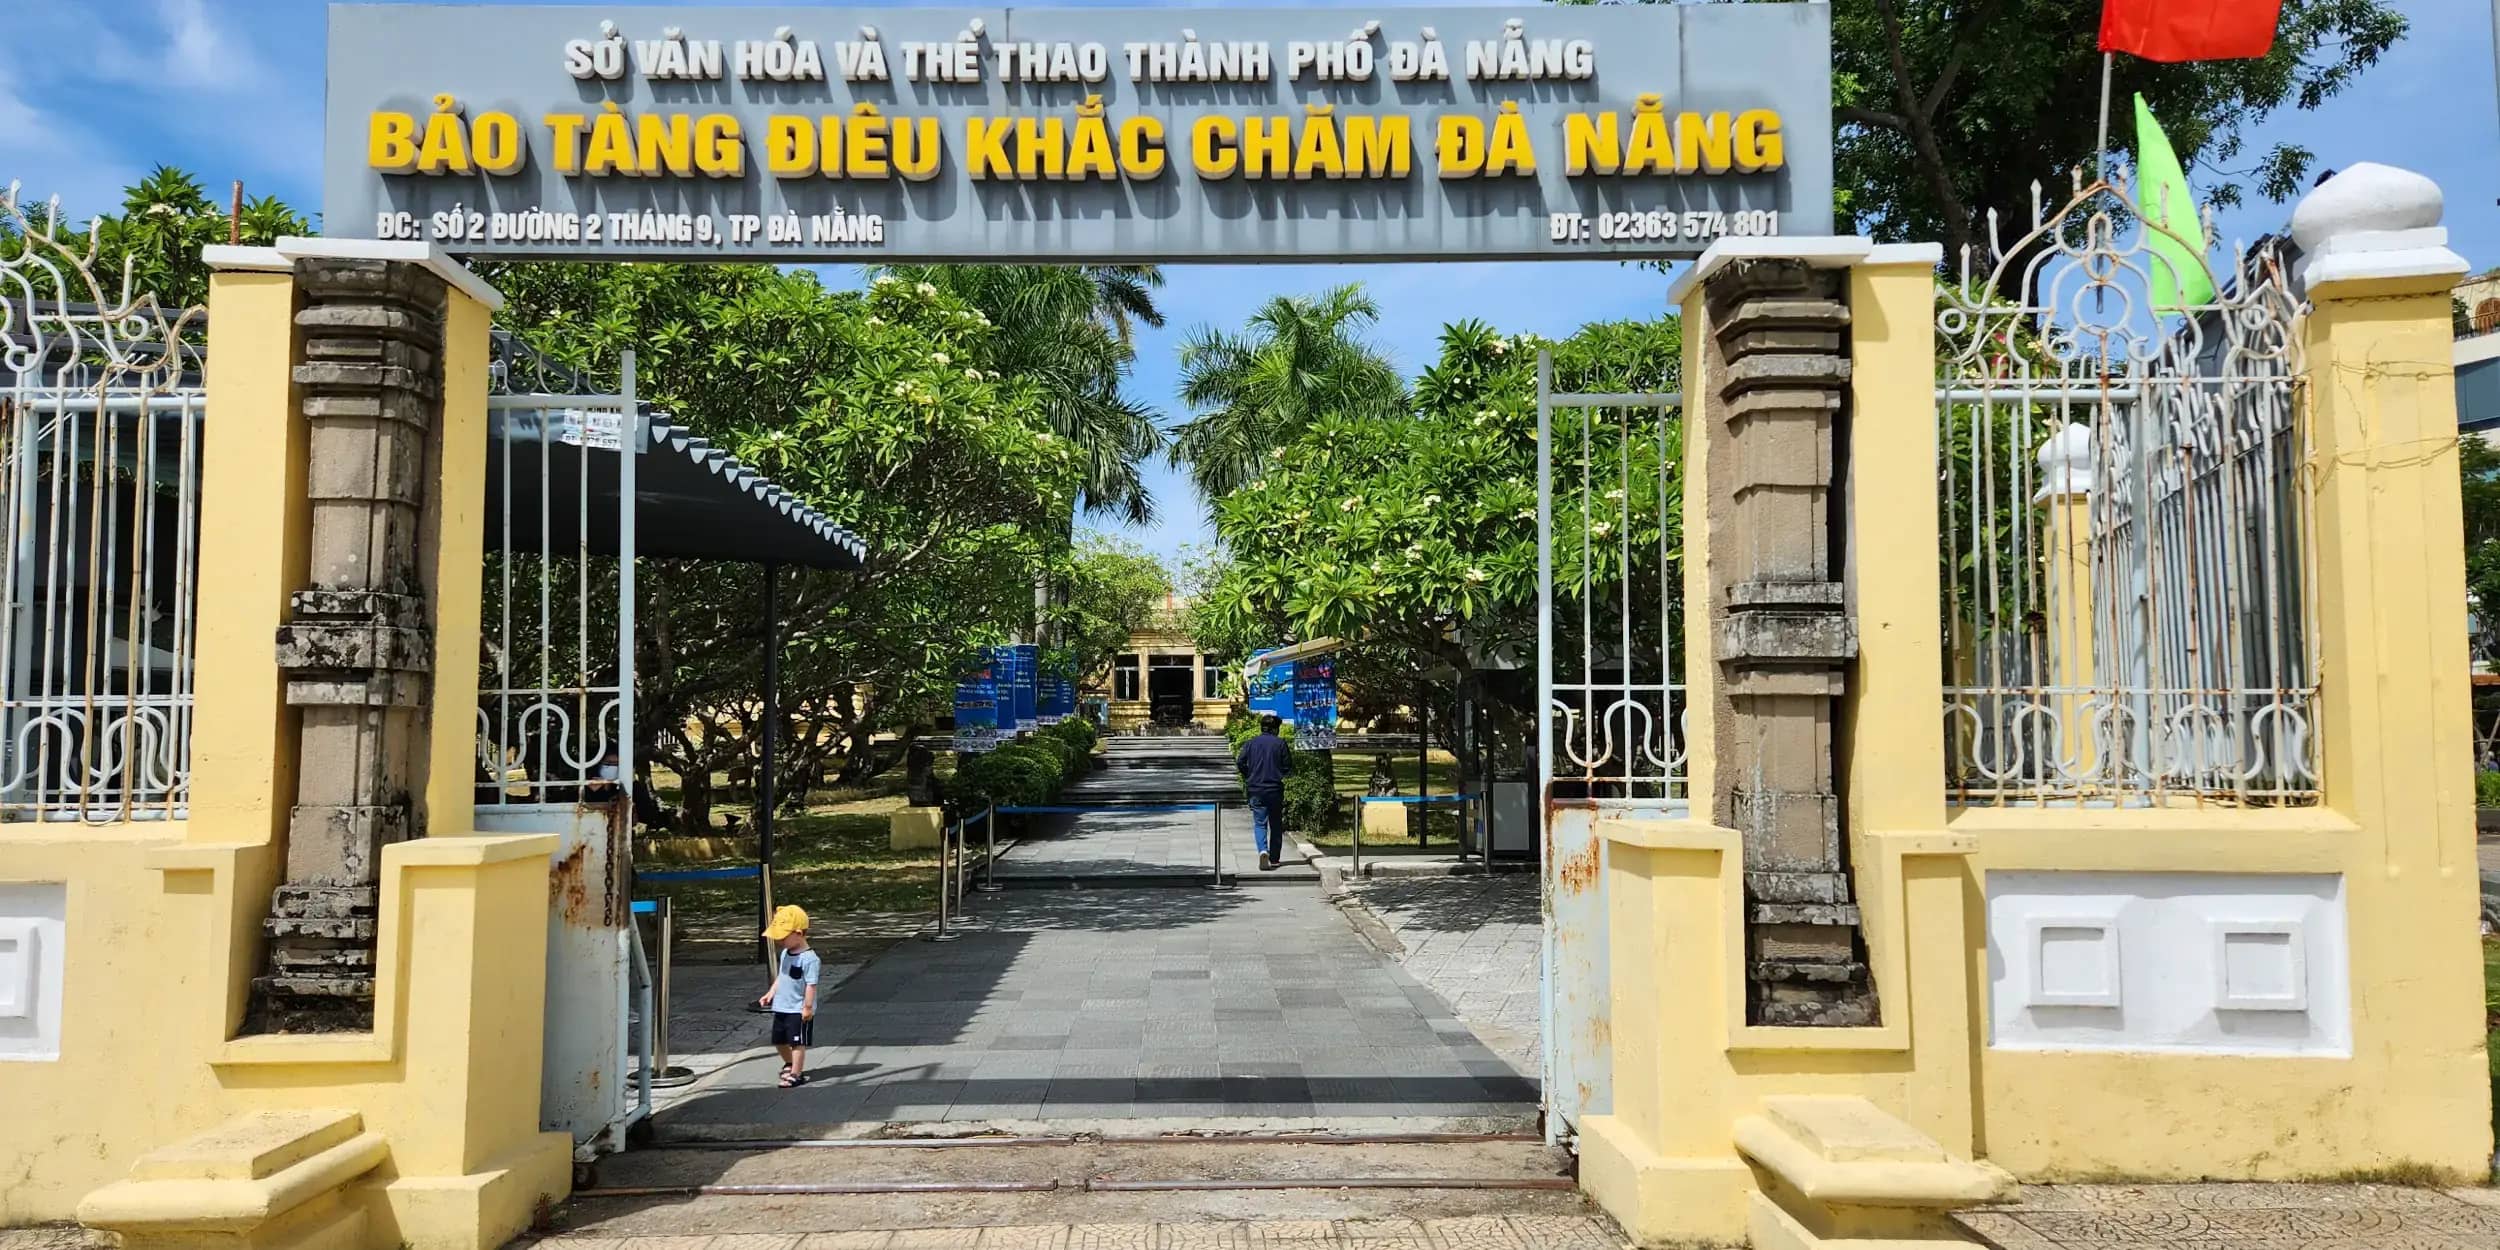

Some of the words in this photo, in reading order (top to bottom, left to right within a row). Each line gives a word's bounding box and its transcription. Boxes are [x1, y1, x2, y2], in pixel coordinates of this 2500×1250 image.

[564, 19, 627, 79] SỞ
[635, 25, 723, 79] VĂN
[735, 25, 824, 81] HÓA
[834, 25, 889, 81] VÀ
[901, 17, 980, 82] THỂ
[992, 41, 1107, 83] THAO
[1124, 28, 1270, 82] THÀNH
[1288, 20, 1380, 82] PHỐ
[1389, 26, 1449, 80] ĐÀ
[368, 92, 525, 176] BẢO
[543, 99, 745, 178] TÀNG
[765, 102, 941, 181] ĐIÊU
[966, 94, 1165, 180] KHẮC
[1191, 103, 1411, 180] CHĂM
[1434, 101, 1537, 179] ĐÀ
[377, 211, 421, 240] ĐC:
[431, 202, 465, 240] SỐ
[468, 212, 486, 240] 2
[491, 205, 580, 241] ĐƯỜNG
[585, 213, 602, 241] 2
[608, 207, 693, 242] THÁNG
[696, 214, 722, 246] 9,
[728, 213, 762, 243] TP
[767, 208, 803, 244] ĐÀ
[1550, 212, 1590, 240] ĐT:
[1599, 211, 1678, 240] 02363
[1682, 210, 1728, 238] 574
[1733, 209, 1779, 236] 801
